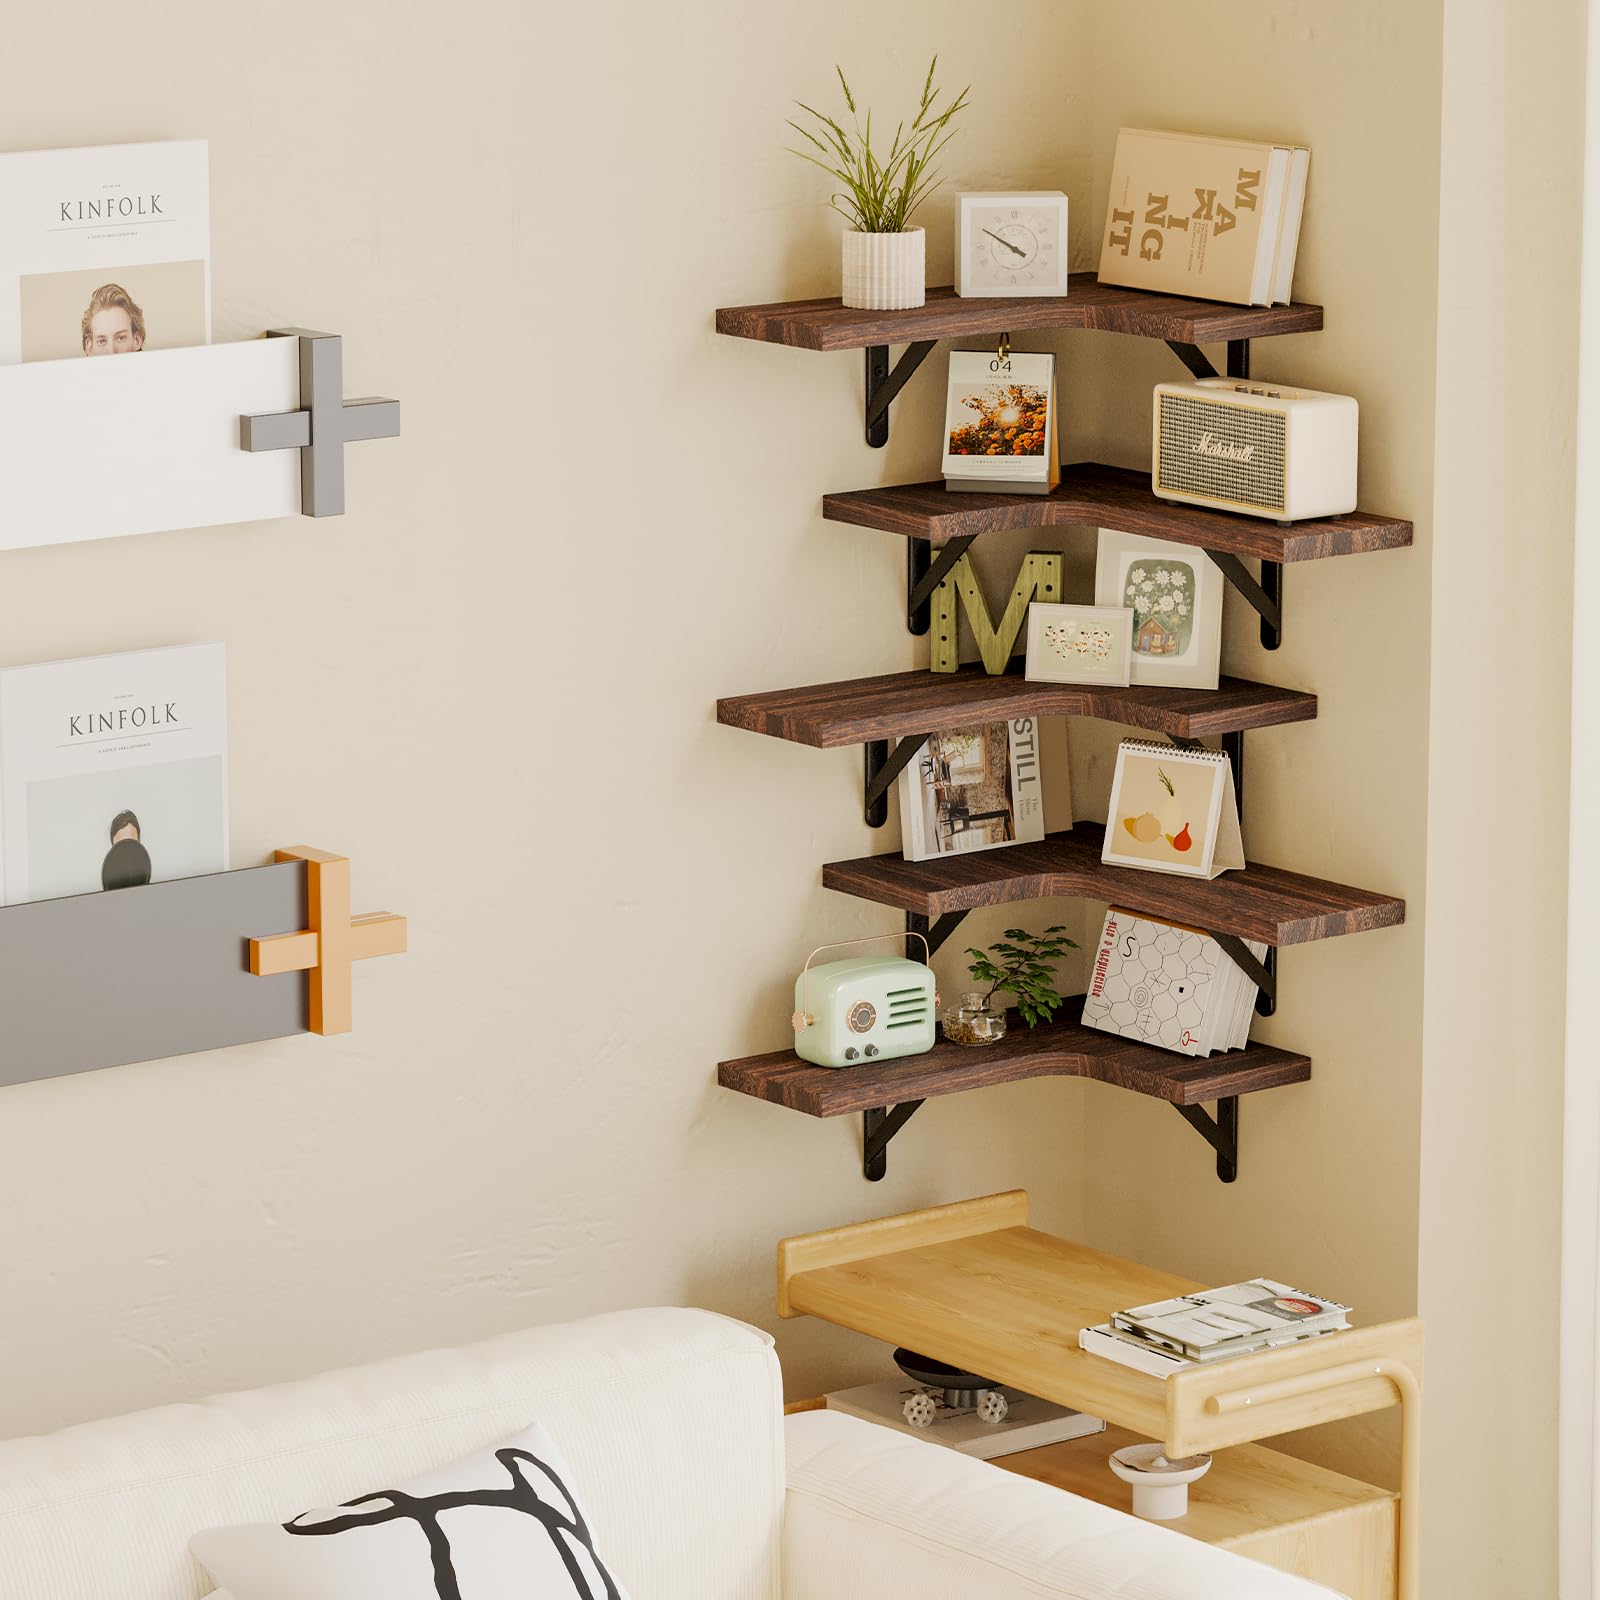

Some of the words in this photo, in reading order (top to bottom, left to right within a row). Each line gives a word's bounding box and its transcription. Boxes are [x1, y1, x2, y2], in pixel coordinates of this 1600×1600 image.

[60, 195, 163, 221] KINFOLK
[1108, 208, 1135, 256] IT
[989, 360, 1012, 372] 04
[1192, 432, 1255, 461] Marshall
[70, 702, 178, 736] KINFOLK
[1013, 717, 1036, 793] STILL
